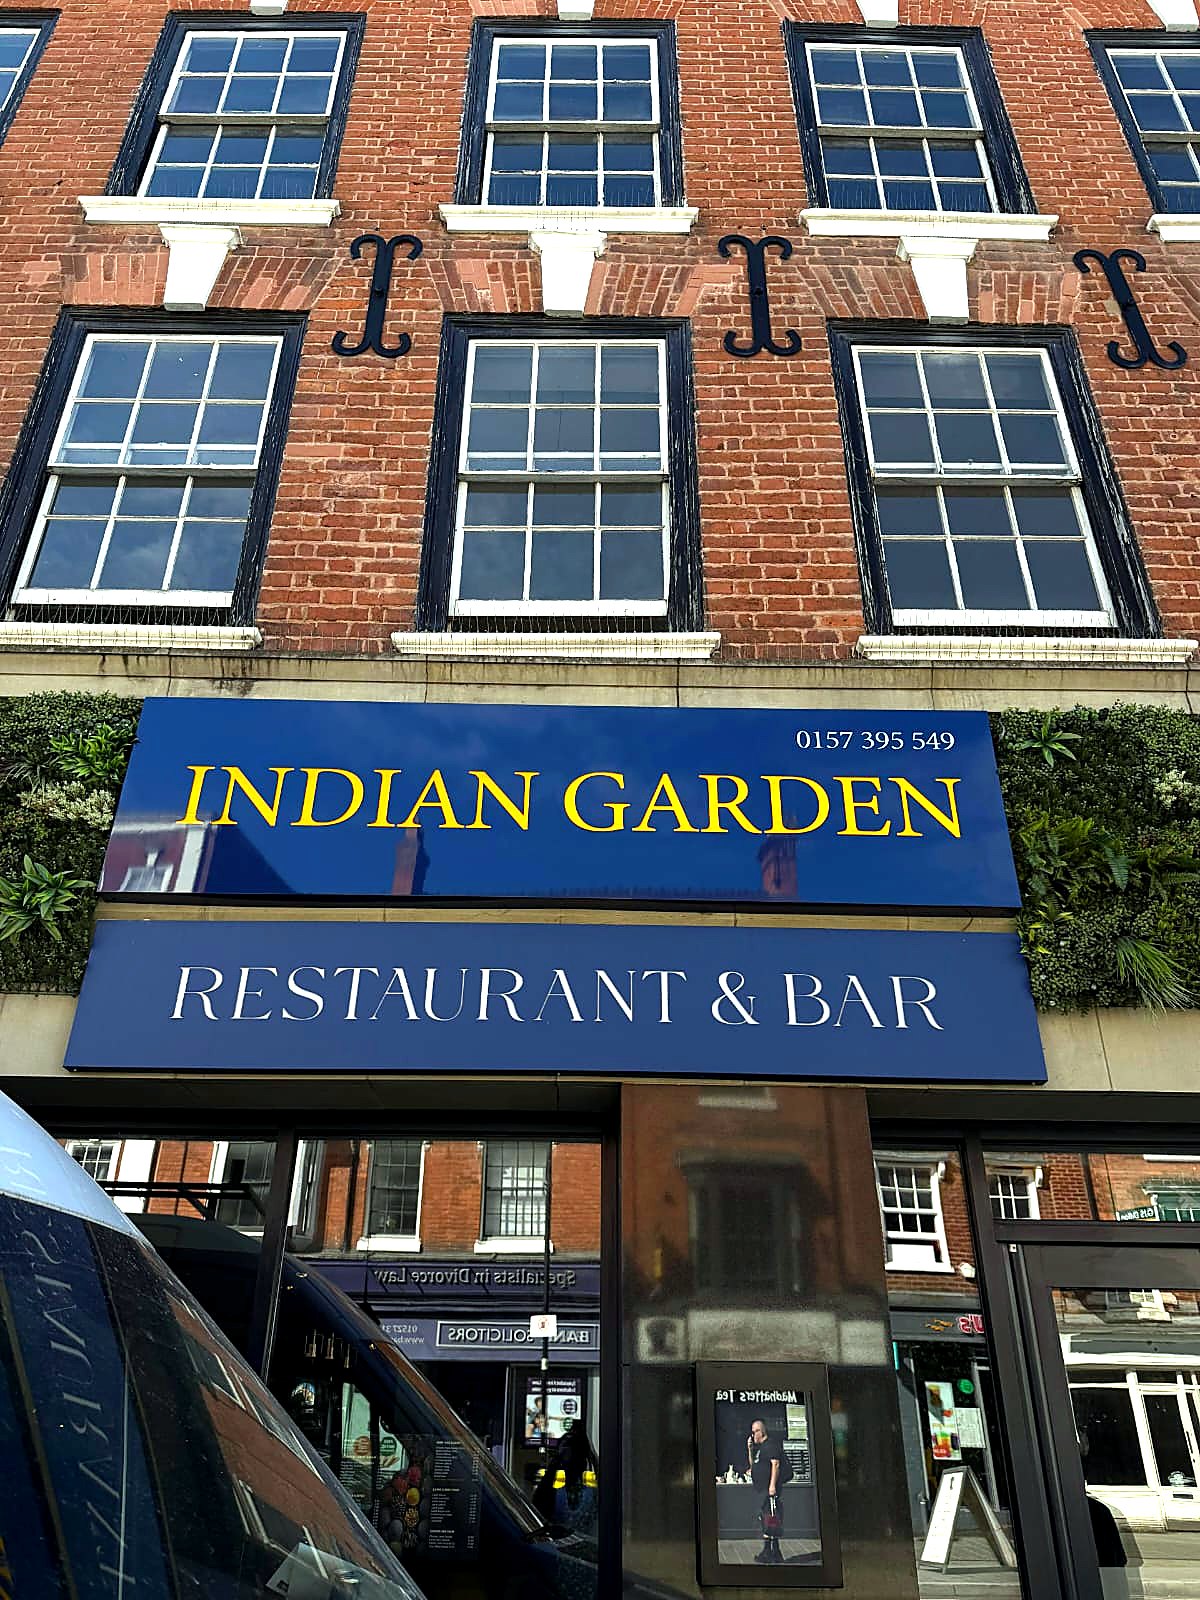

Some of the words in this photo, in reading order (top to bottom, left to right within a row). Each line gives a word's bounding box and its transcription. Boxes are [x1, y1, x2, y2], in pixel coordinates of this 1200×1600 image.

[796, 730, 853, 750] 0157
[861, 731, 904, 750] 395
[912, 732, 955, 751] 549
[176, 765, 540, 831] INDIAN
[563, 771, 962, 839] GARDEN
[170, 966, 688, 1023] RESTAURANT
[711, 970, 760, 1026] &
[783, 972, 944, 1030] BAR
